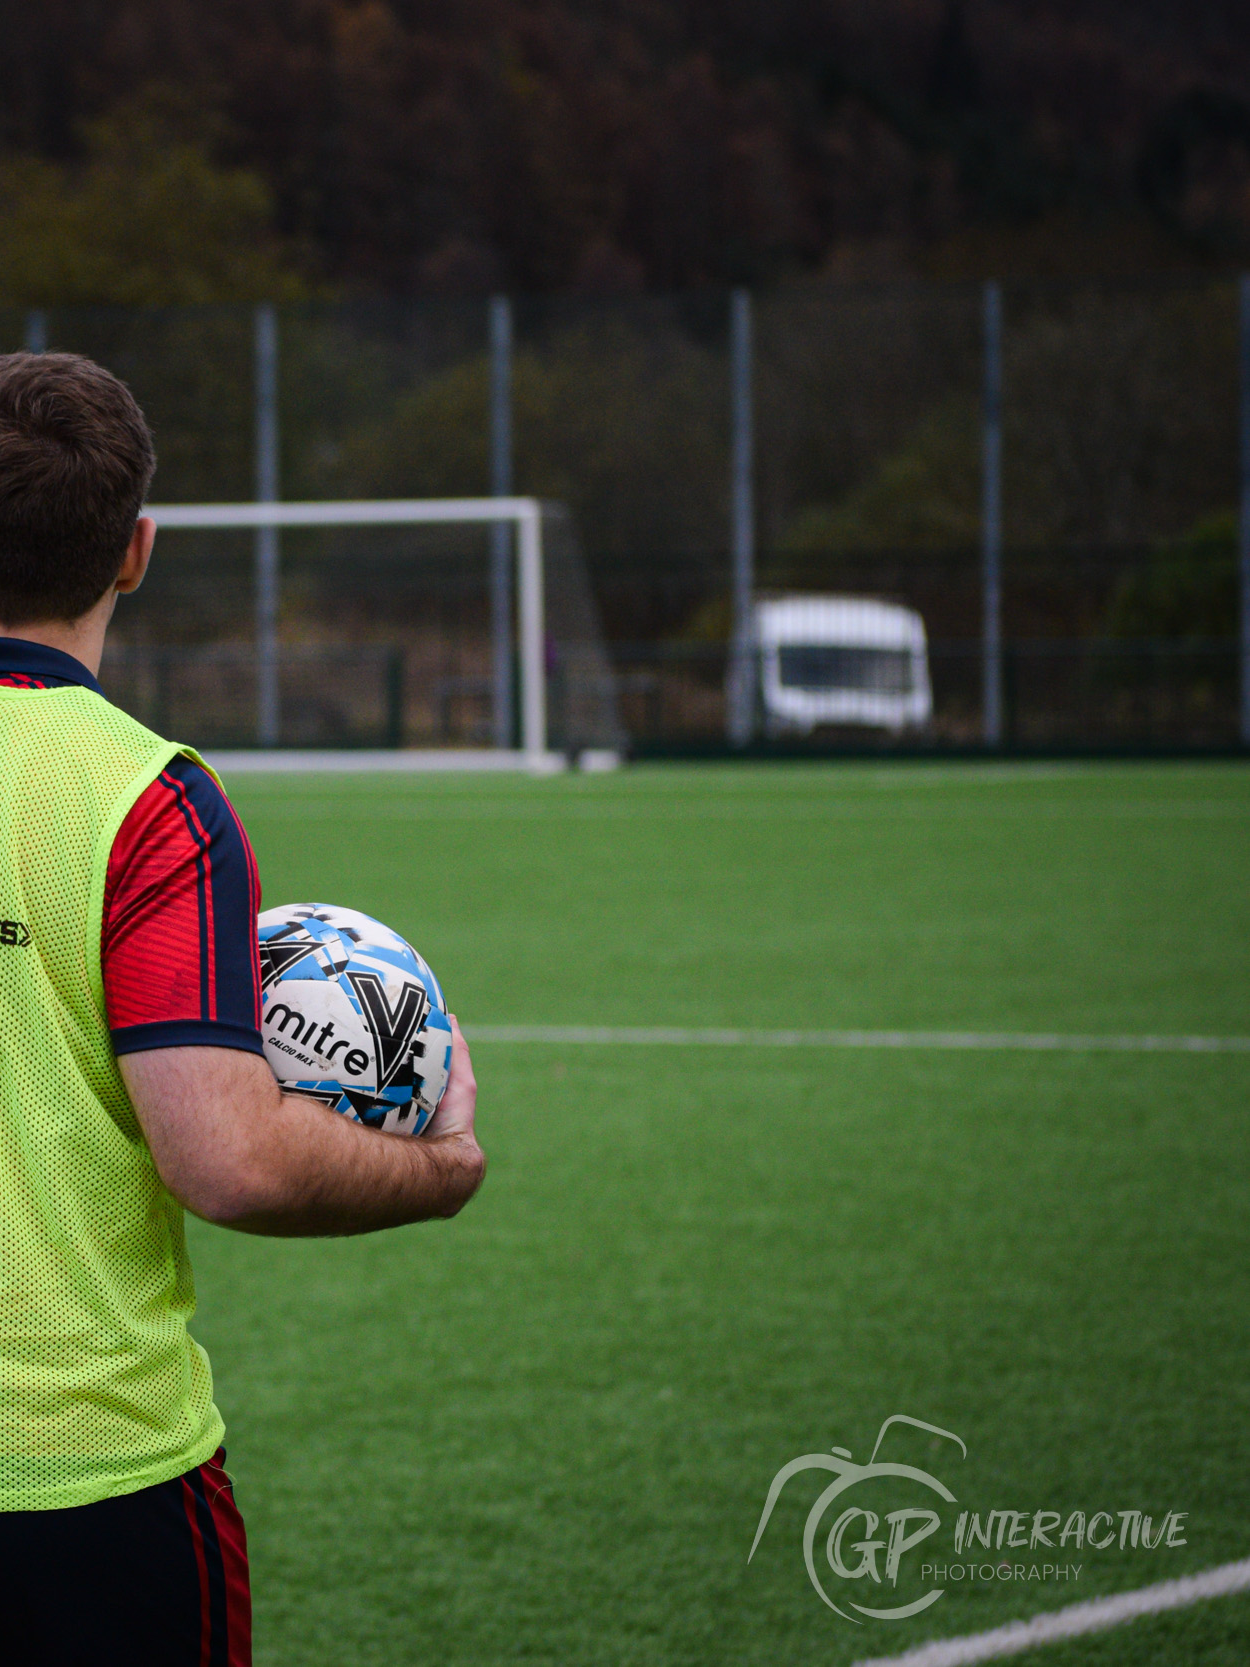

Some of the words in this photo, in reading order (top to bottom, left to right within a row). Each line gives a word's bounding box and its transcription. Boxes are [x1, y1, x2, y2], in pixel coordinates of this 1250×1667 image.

[264, 1003, 370, 1076] mitre
[268, 1037, 297, 1056] CALCIO
[294, 1052, 316, 1067] MAX
